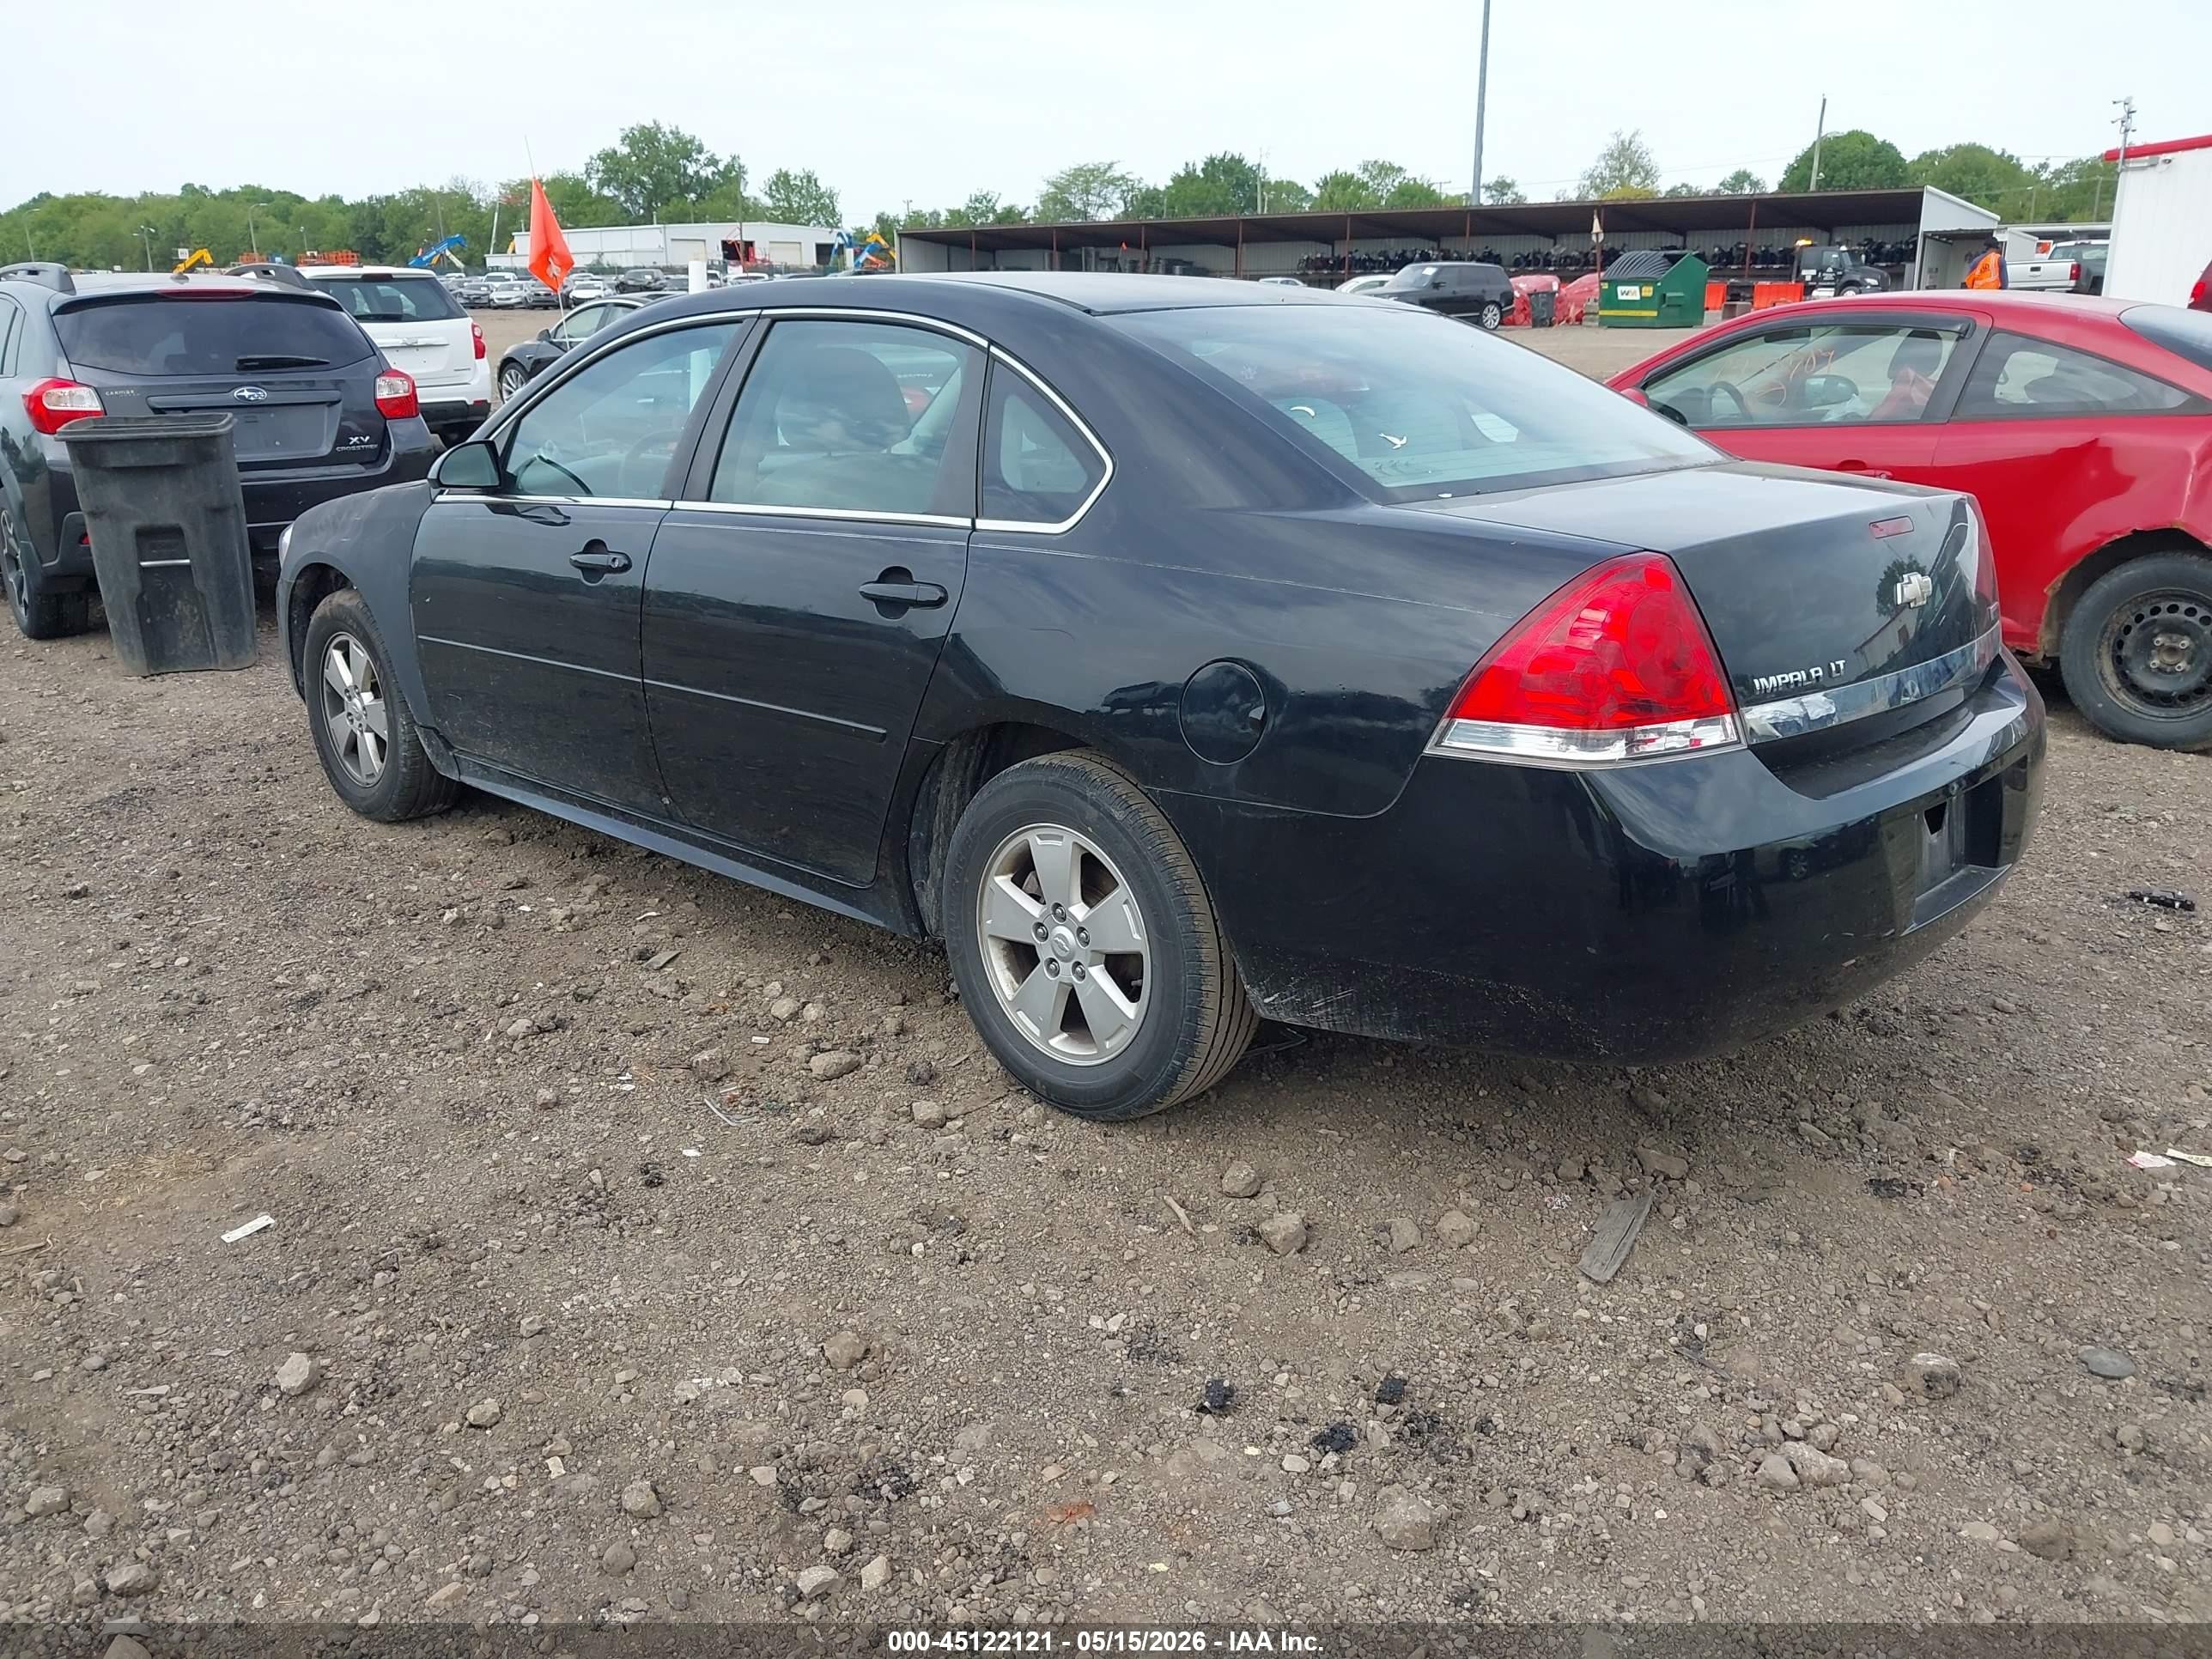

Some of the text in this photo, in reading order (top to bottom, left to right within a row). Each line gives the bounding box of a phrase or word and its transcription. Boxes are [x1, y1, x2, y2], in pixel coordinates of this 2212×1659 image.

[349, 435, 370, 445] XV
[1753, 659, 1846, 693] IMPALA LT
